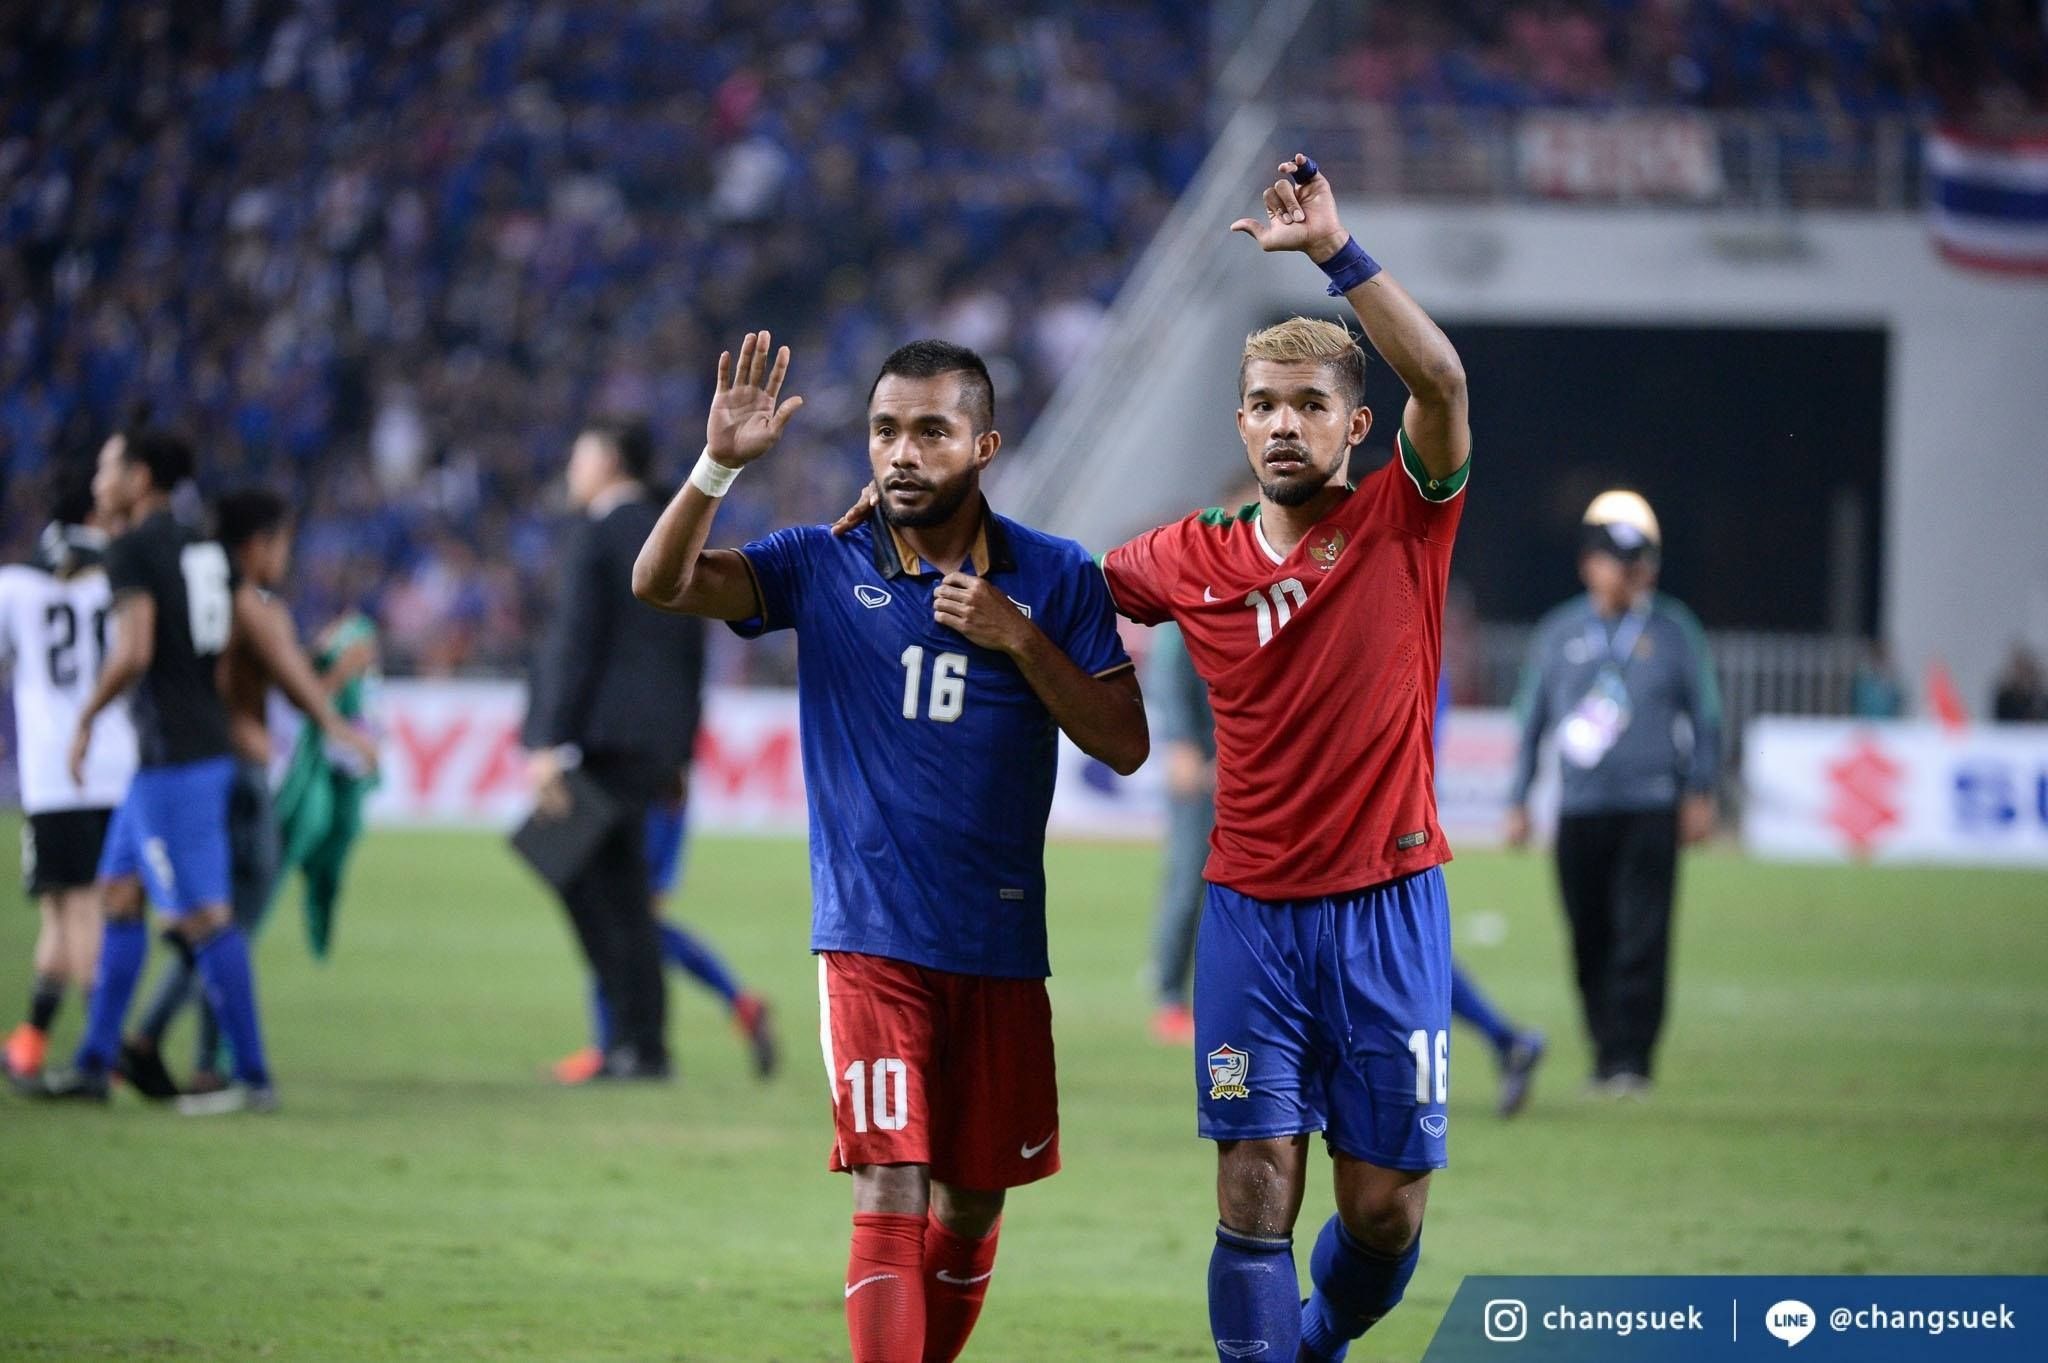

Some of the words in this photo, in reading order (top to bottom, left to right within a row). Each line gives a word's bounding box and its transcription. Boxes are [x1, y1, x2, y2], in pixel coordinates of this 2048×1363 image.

[901, 645, 968, 722] 16
[844, 1057, 909, 1133] 10
[1408, 1029, 1448, 1104] 16
